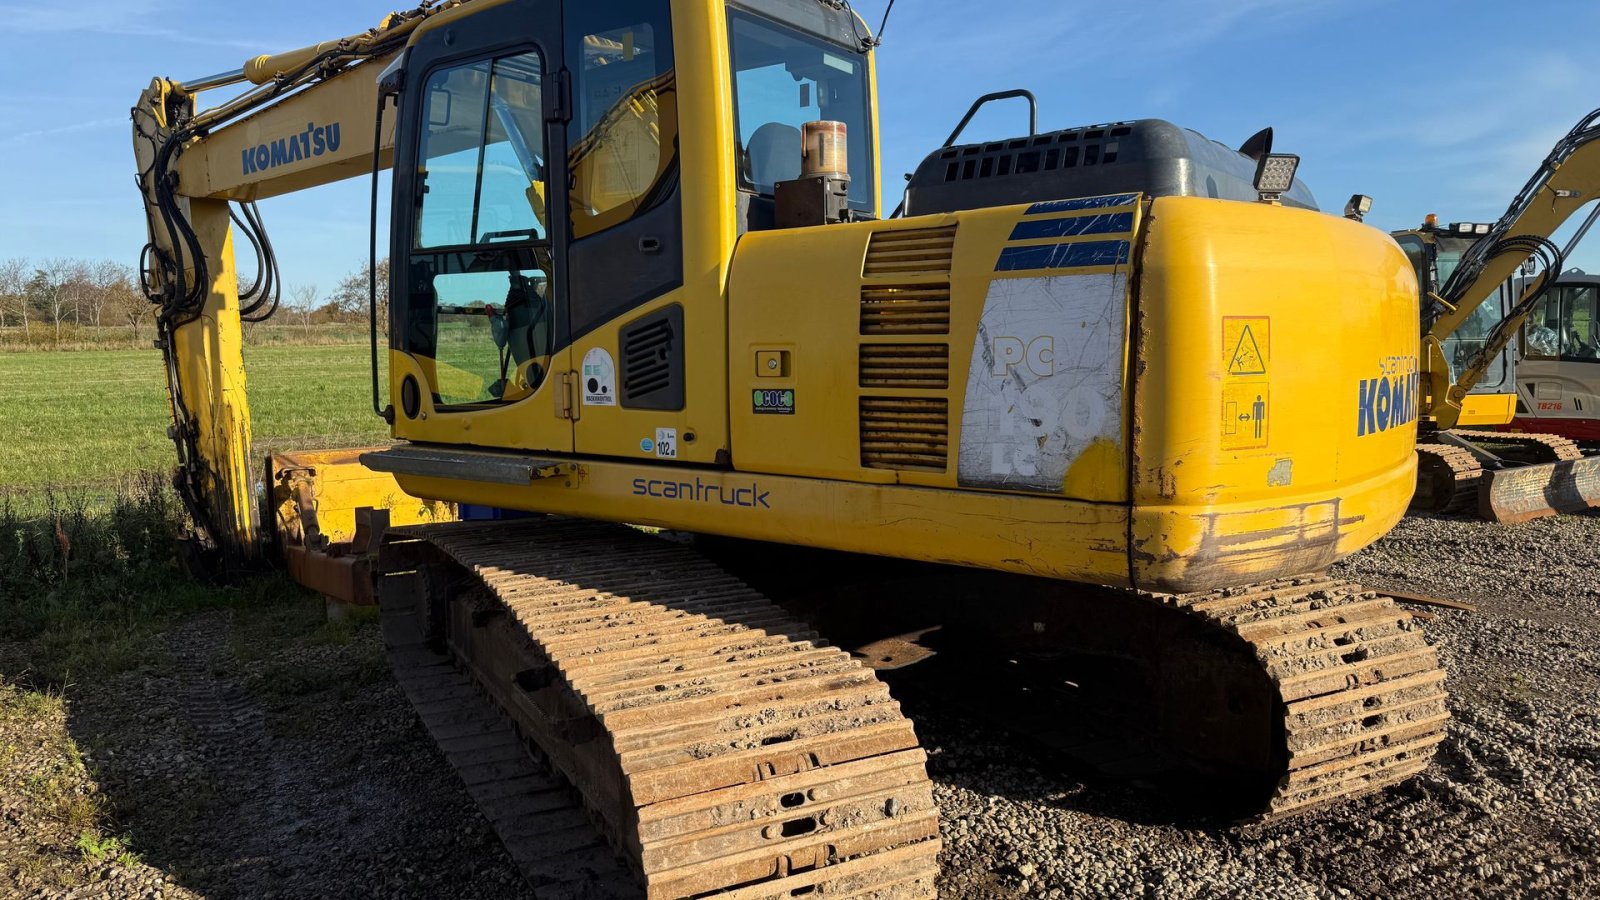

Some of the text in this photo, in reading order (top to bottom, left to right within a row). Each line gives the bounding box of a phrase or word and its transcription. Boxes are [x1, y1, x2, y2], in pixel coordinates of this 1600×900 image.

[242, 122, 341, 175] KOMATSU
[992, 335, 1054, 378] PC
[1537, 402, 1563, 411] TB216
[657, 441, 670, 456] 102
[632, 477, 770, 508] scantruck
